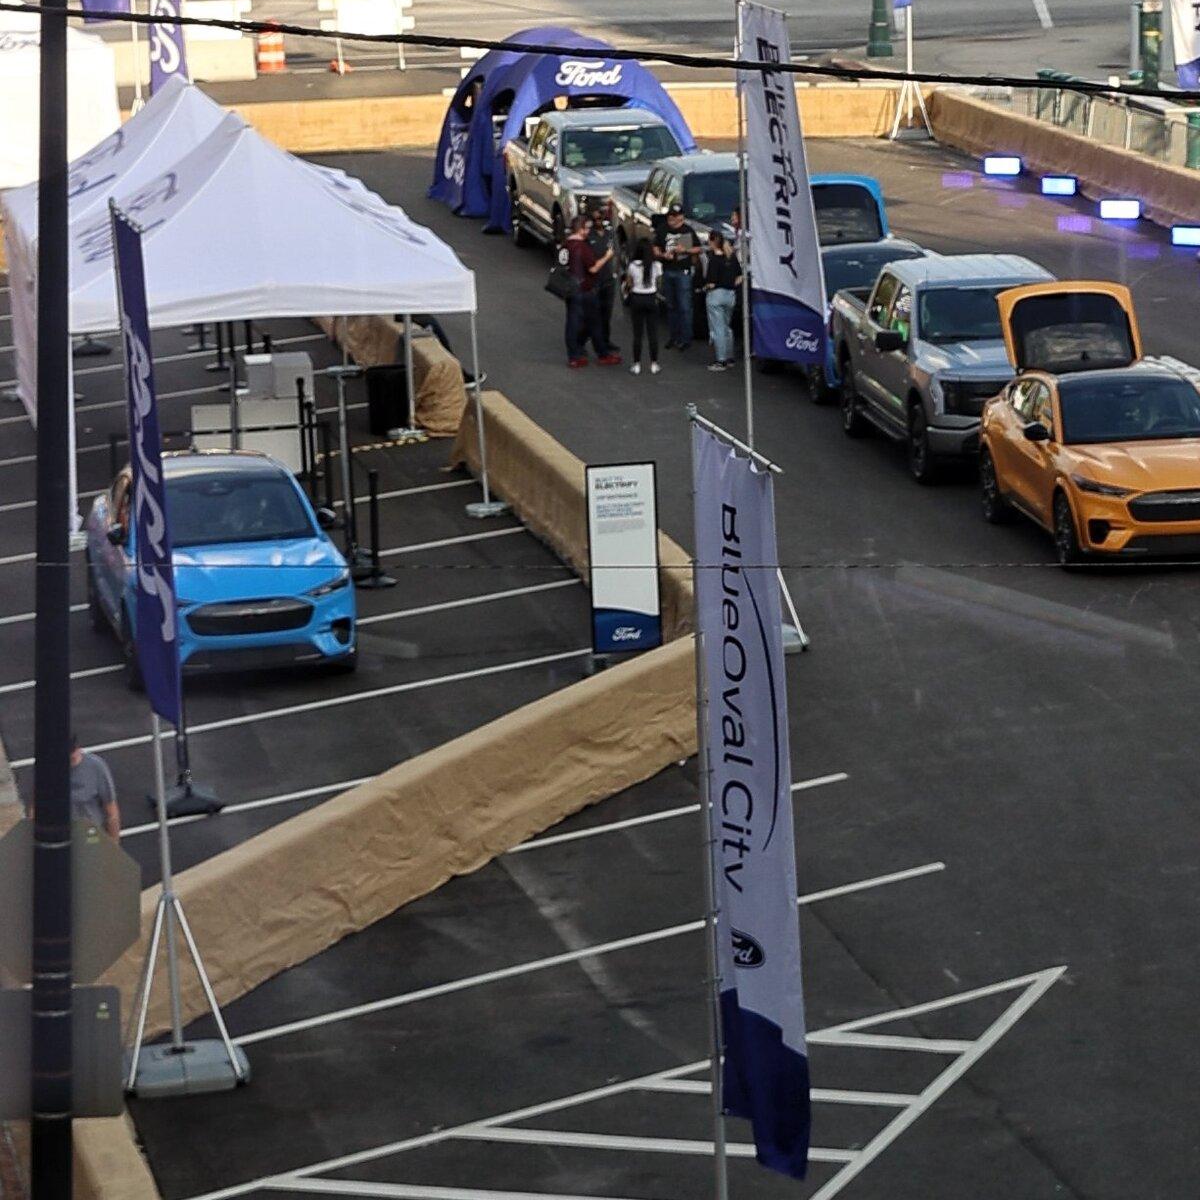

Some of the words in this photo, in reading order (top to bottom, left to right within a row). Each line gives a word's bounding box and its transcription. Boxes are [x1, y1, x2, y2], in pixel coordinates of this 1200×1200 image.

[555, 60, 623, 87] Ford
[756, 36, 798, 279] ELECTRIFY
[785, 328, 820, 353] Ford
[611, 626, 642, 642] Ford
[720, 502, 753, 767] BlueOval
